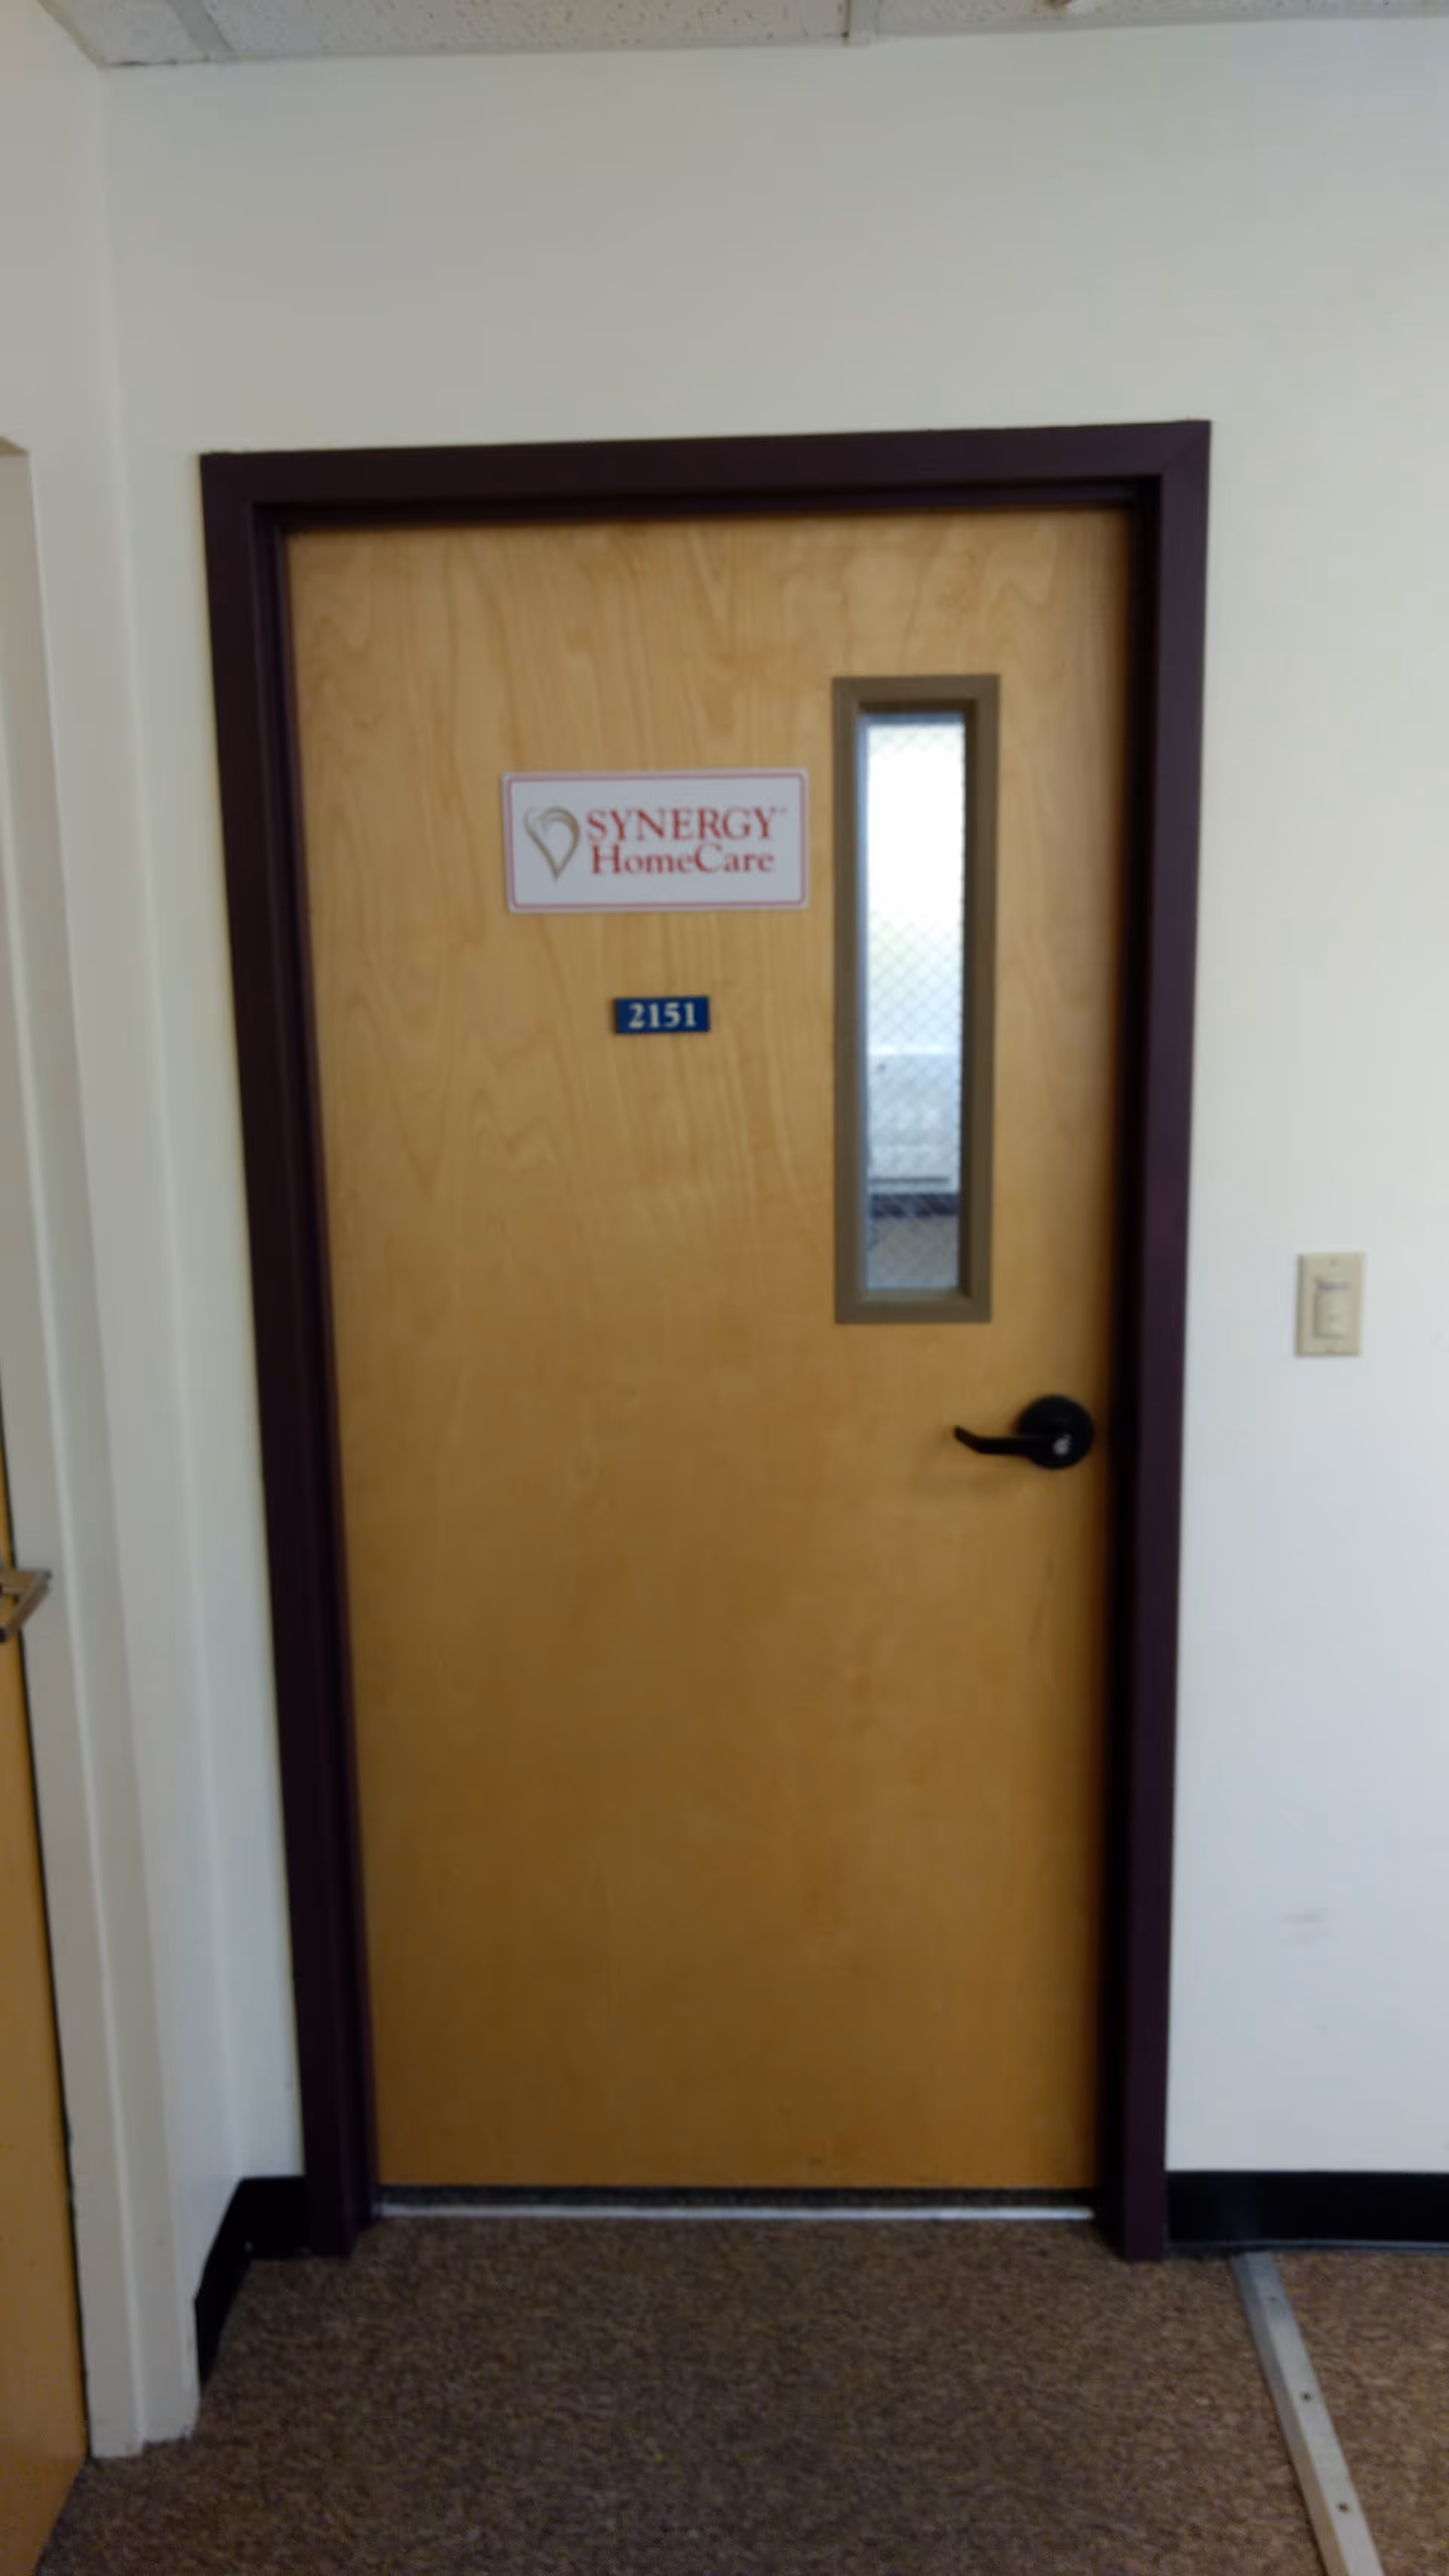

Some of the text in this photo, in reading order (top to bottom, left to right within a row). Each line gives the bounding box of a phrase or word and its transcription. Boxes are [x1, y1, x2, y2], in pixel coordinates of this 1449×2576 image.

[586, 806, 775, 842] SYNERGY
[591, 843, 774, 875] HomeCare
[629, 1002, 696, 1029] 2151
